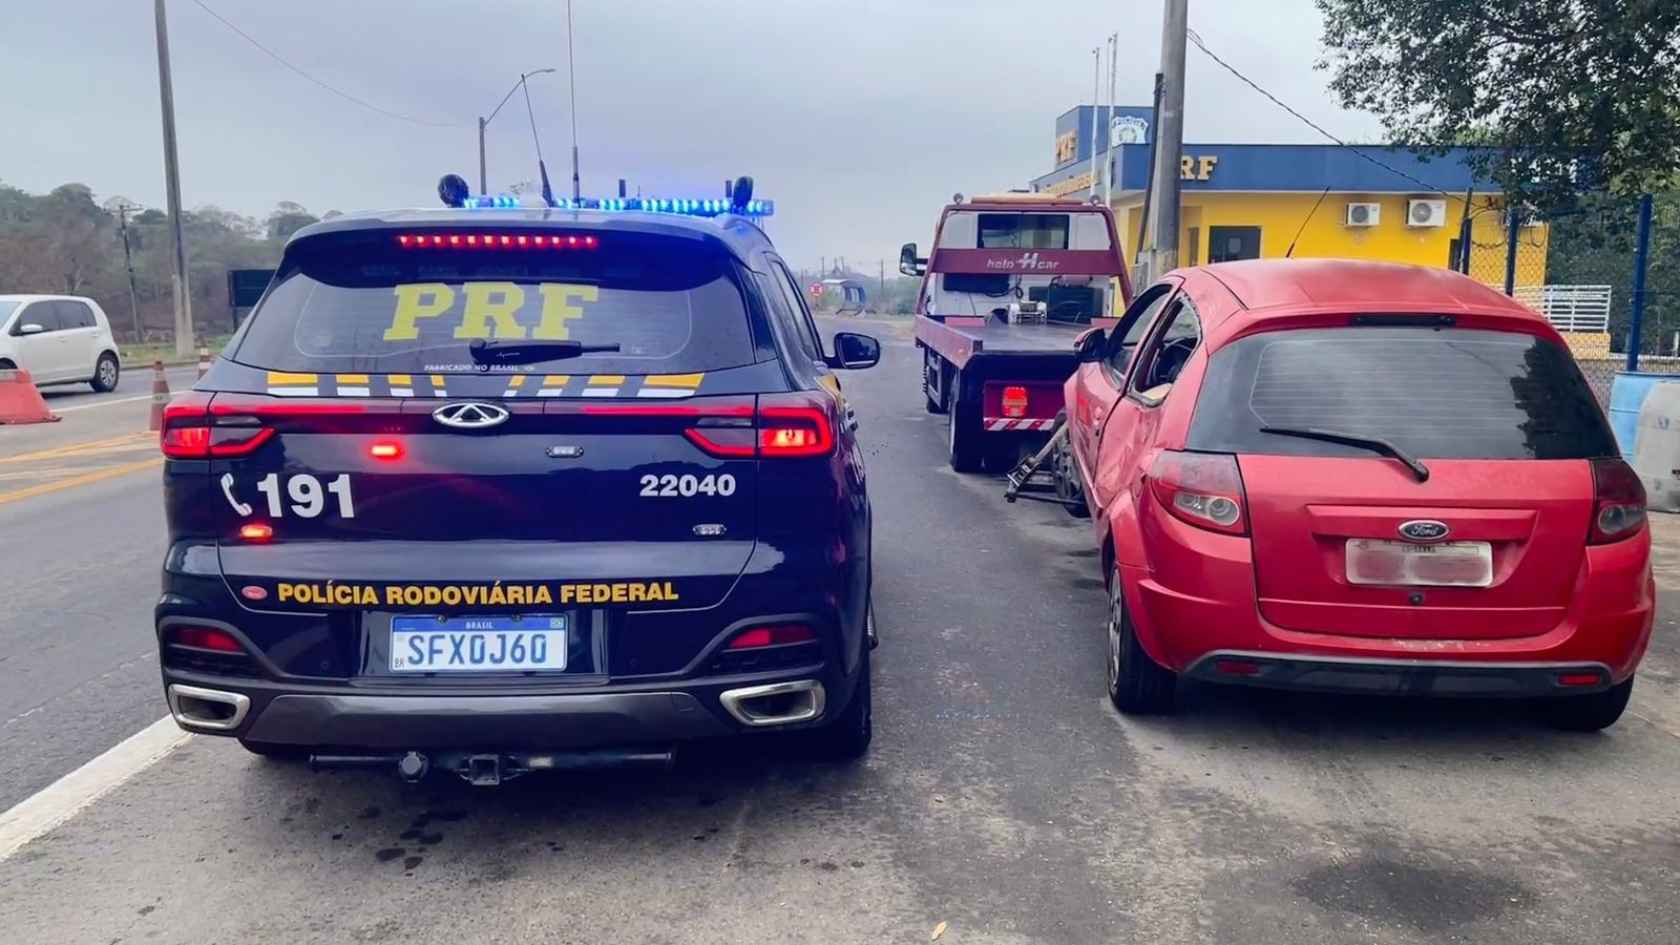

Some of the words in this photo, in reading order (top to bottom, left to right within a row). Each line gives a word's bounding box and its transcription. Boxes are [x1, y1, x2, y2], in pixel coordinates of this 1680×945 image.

[1180, 155, 1217, 180] RF
[383, 281, 598, 340] PRF
[257, 473, 354, 518] 191
[640, 474, 736, 497] 22040
[1411, 523, 1439, 536] Ford
[278, 579, 379, 604] POLÍCIA
[386, 579, 552, 605] RODOVIÁRIA
[560, 582, 679, 603] FEDERAL
[465, 621, 494, 630] BRASIL
[408, 634, 546, 665] SFX0J60
